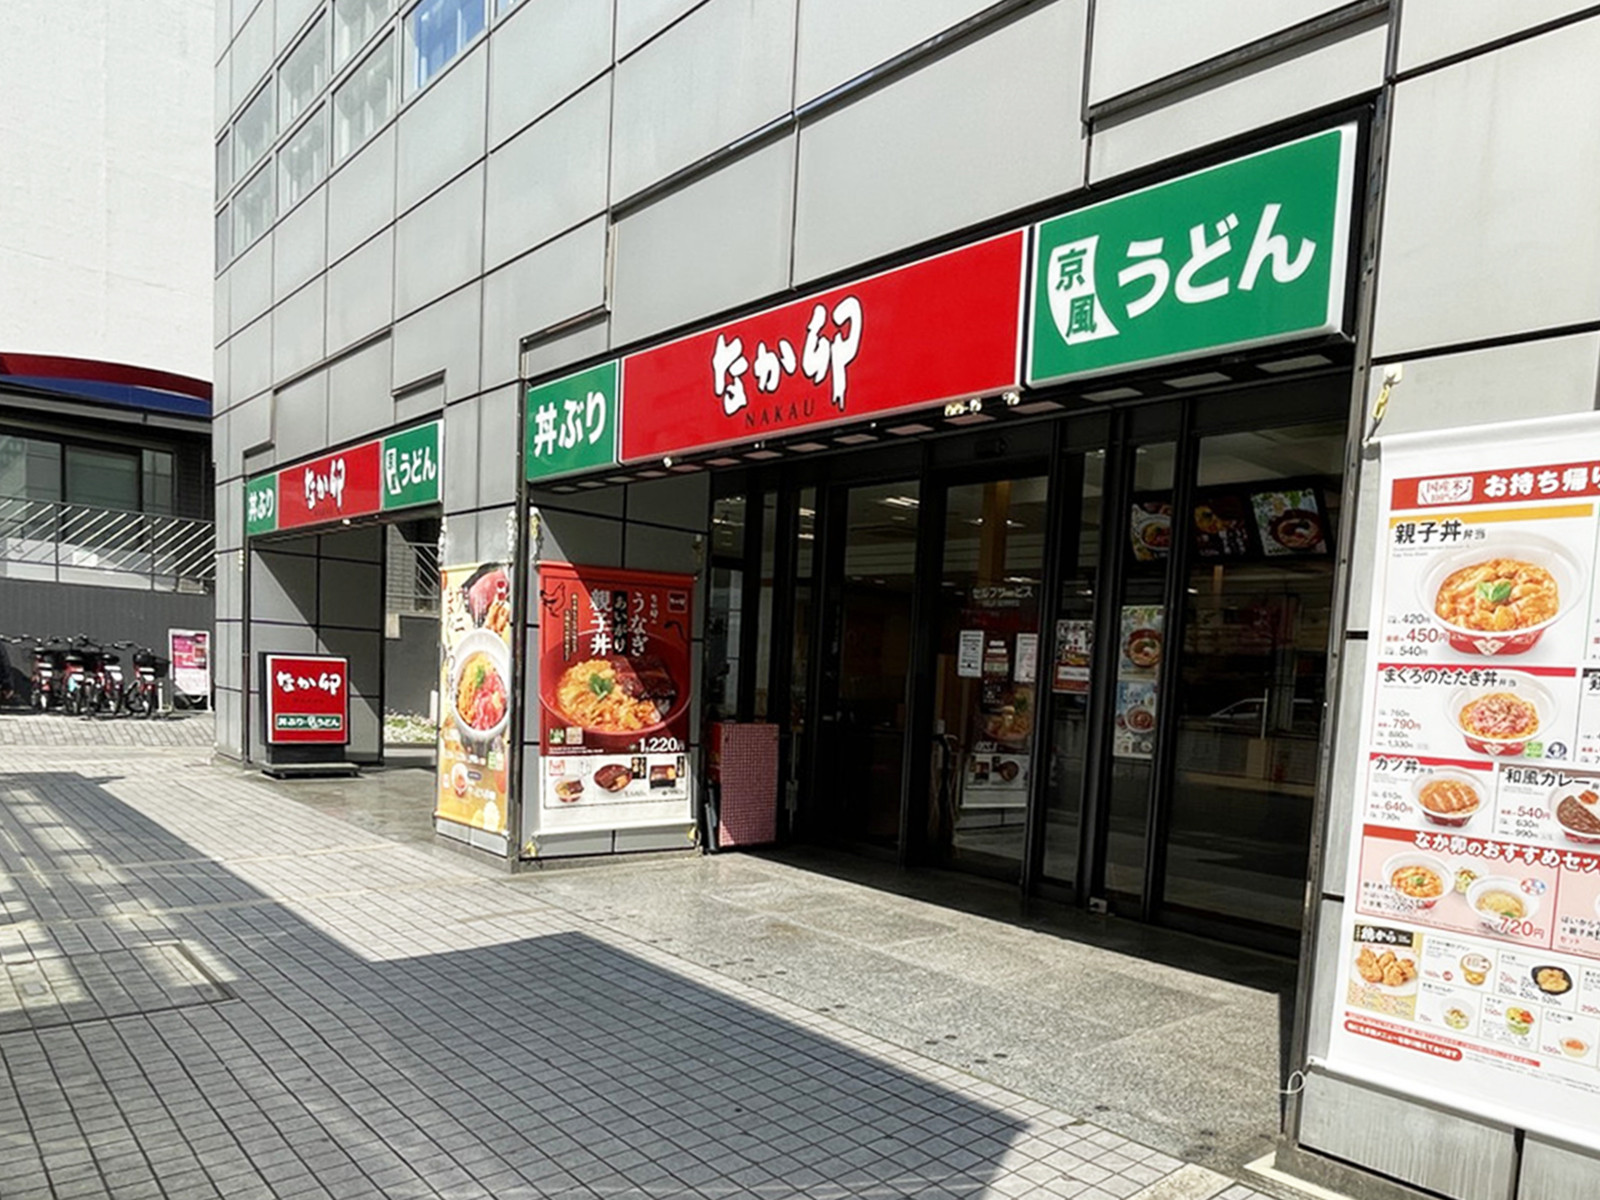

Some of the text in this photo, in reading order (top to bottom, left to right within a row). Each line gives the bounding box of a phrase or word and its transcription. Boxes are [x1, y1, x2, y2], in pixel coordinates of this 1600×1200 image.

[1056, 247, 1097, 338] 京風
[1118, 203, 1317, 319] うどん
[712, 295, 863, 416] なか卯
[534, 391, 607, 457] 丼ぶり
[744, 398, 817, 429] NAKAU
[304, 457, 346, 511] なか卯
[400, 447, 437, 487] うどん
[248, 488, 275, 522] 丼ぶり
[589, 588, 613, 657] 親子丼
[630, 591, 649, 657] うなぎ
[276, 671, 342, 696] なか卯
